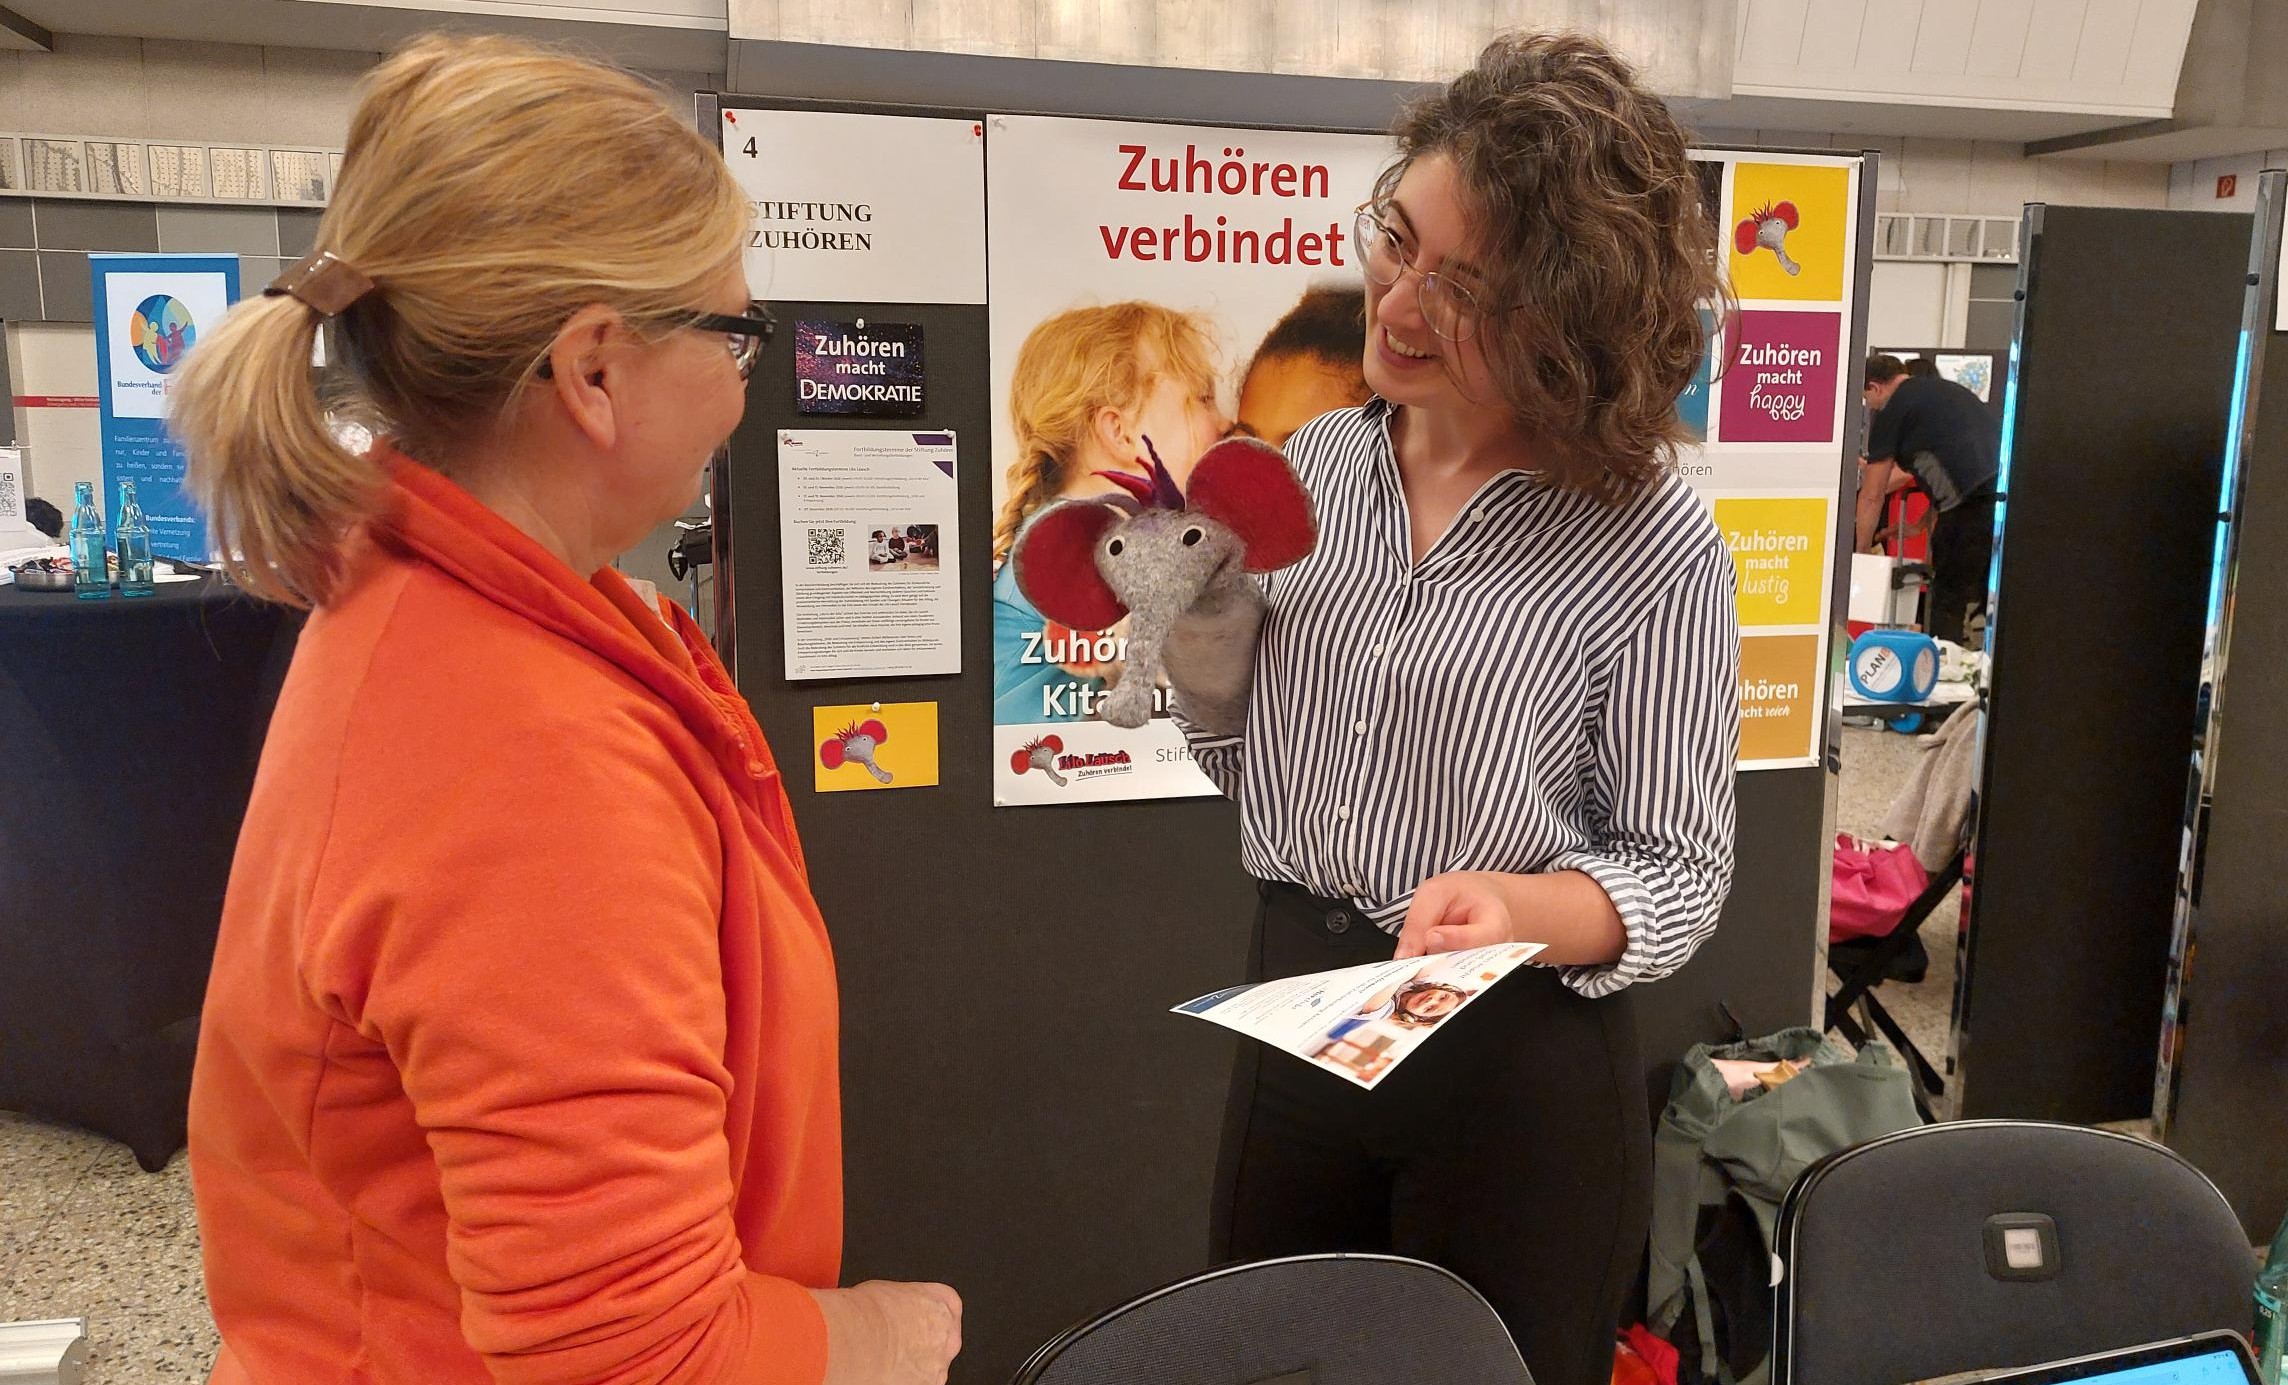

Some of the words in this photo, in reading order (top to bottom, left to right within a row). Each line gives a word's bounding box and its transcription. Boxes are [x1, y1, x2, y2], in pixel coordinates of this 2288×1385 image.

[743, 136, 758, 158] 4
[1118, 143, 1329, 198] Zuhören
[749, 201, 872, 222] STIFTUNG
[748, 228, 872, 251] ZUHÖREN
[1099, 215, 1345, 267] verbindet
[815, 334, 905, 358] Zuhören
[1740, 343, 1821, 366] Zuhören
[835, 360, 886, 376] macht
[1757, 370, 1802, 384] macht
[800, 379, 921, 402] DEMOKRATIE
[1750, 384, 1806, 421] happy
[1729, 530, 1808, 551] Zuhören
[1745, 555, 1789, 570] macht
[1742, 572, 1790, 605] lustig
[1020, 629, 1129, 664] Zuhör
[1155, 746, 1193, 762] Stift
[1078, 768, 1103, 777] Zuhören
